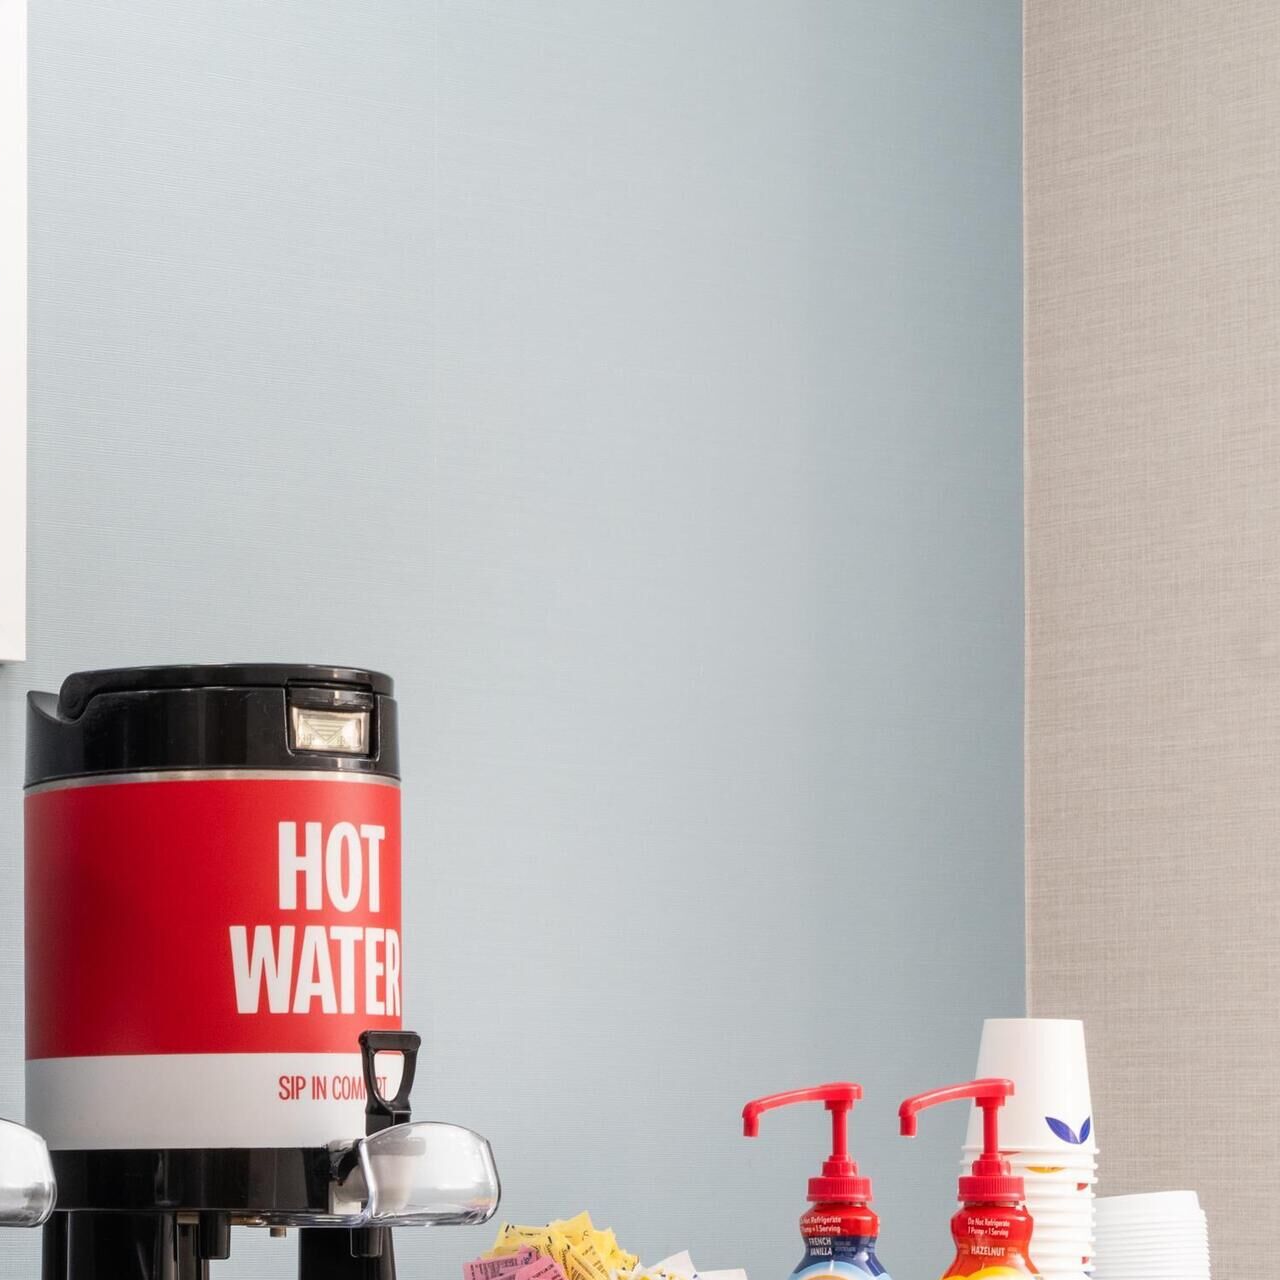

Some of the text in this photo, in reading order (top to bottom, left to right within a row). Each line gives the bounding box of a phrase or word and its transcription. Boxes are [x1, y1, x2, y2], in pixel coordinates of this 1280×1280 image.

[278, 821, 385, 913] HOT
[229, 925, 401, 1017] WATER
[278, 1075, 387, 1101] SIP IN COMRT
[808, 1237, 832, 1246] FRENCH
[970, 1246, 1006, 1257] HAZELNUT
